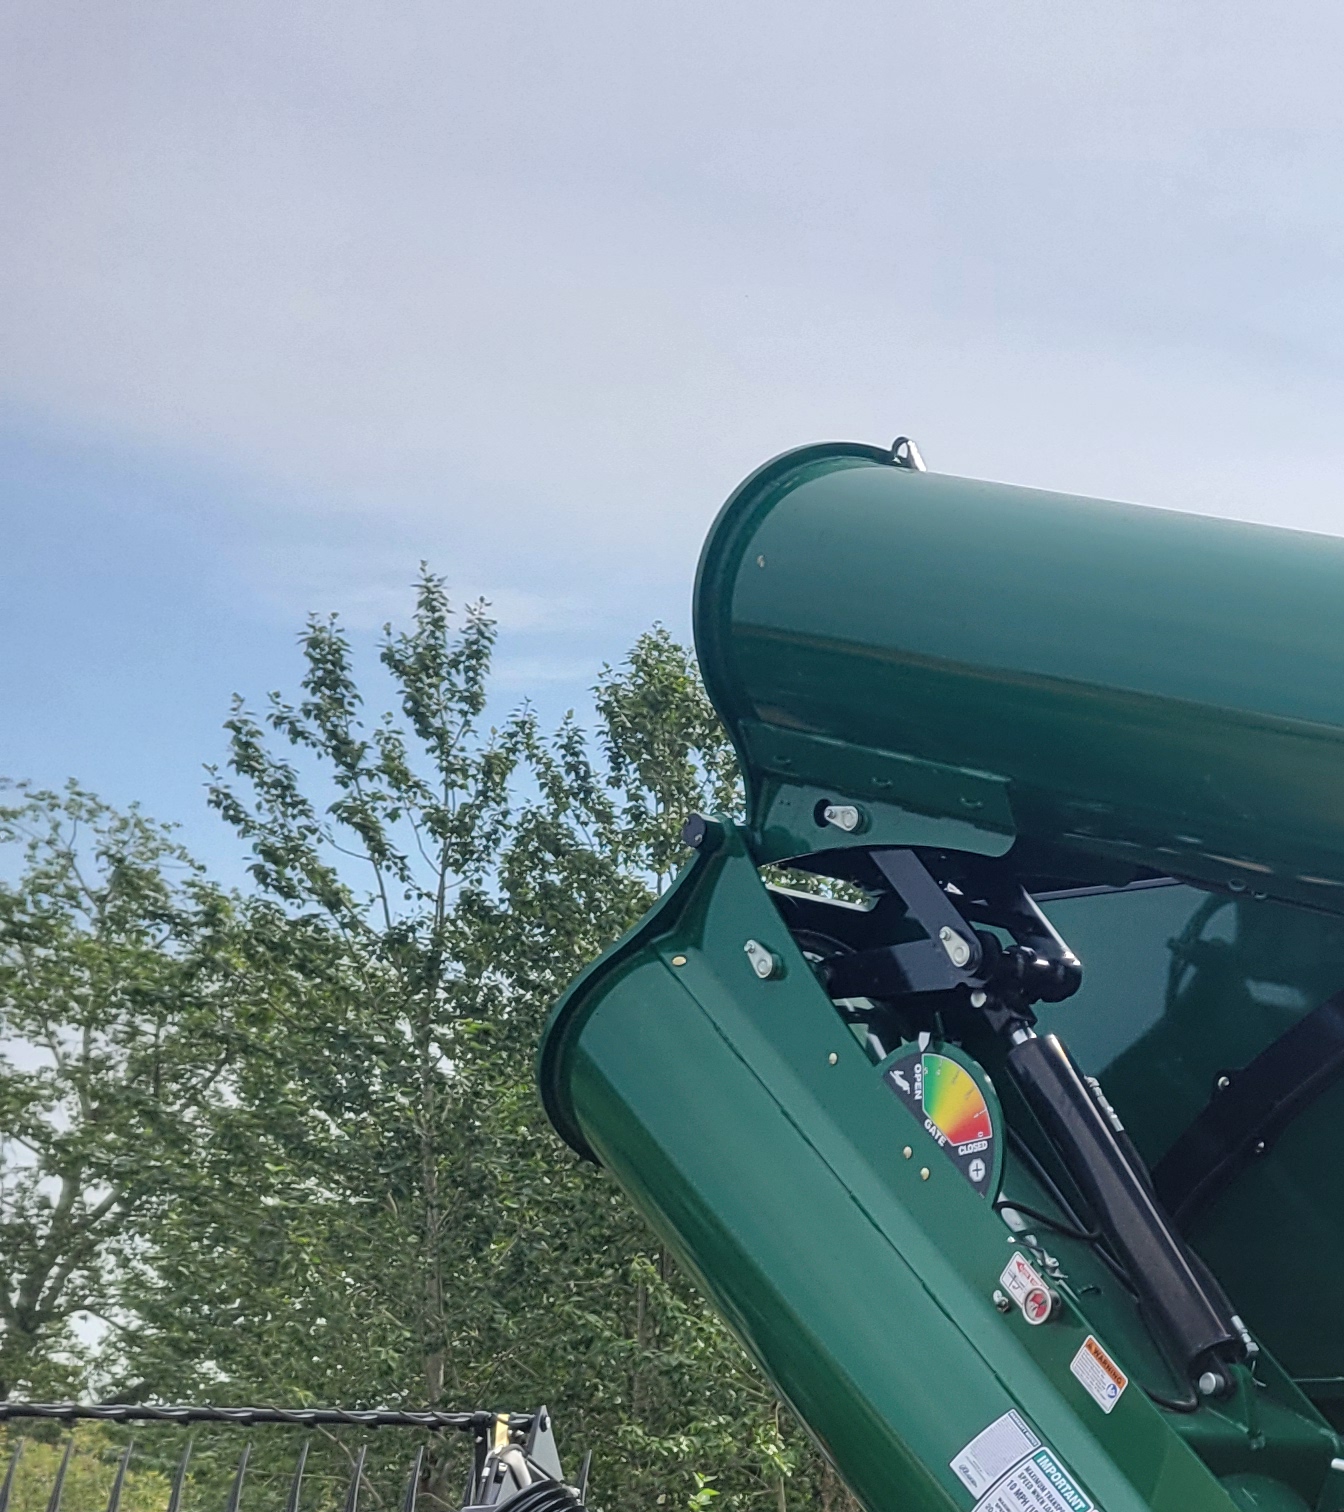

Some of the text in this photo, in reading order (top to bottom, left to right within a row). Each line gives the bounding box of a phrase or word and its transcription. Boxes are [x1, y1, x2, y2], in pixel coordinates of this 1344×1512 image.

[914, 1063, 922, 1100] OPEN
[924, 1118, 947, 1147] GATE
[958, 1140, 988, 1156] CLOSED
[1092, 1349, 1123, 1386] WARNING
[1006, 1479, 1018, 1491] 10
[1013, 1488, 1030, 1507] MPH
[1018, 1472, 1034, 1490] SPEED
[1023, 1465, 1047, 1493] MAXIMUM
[1036, 1454, 1086, 1511] IMPORTANT
